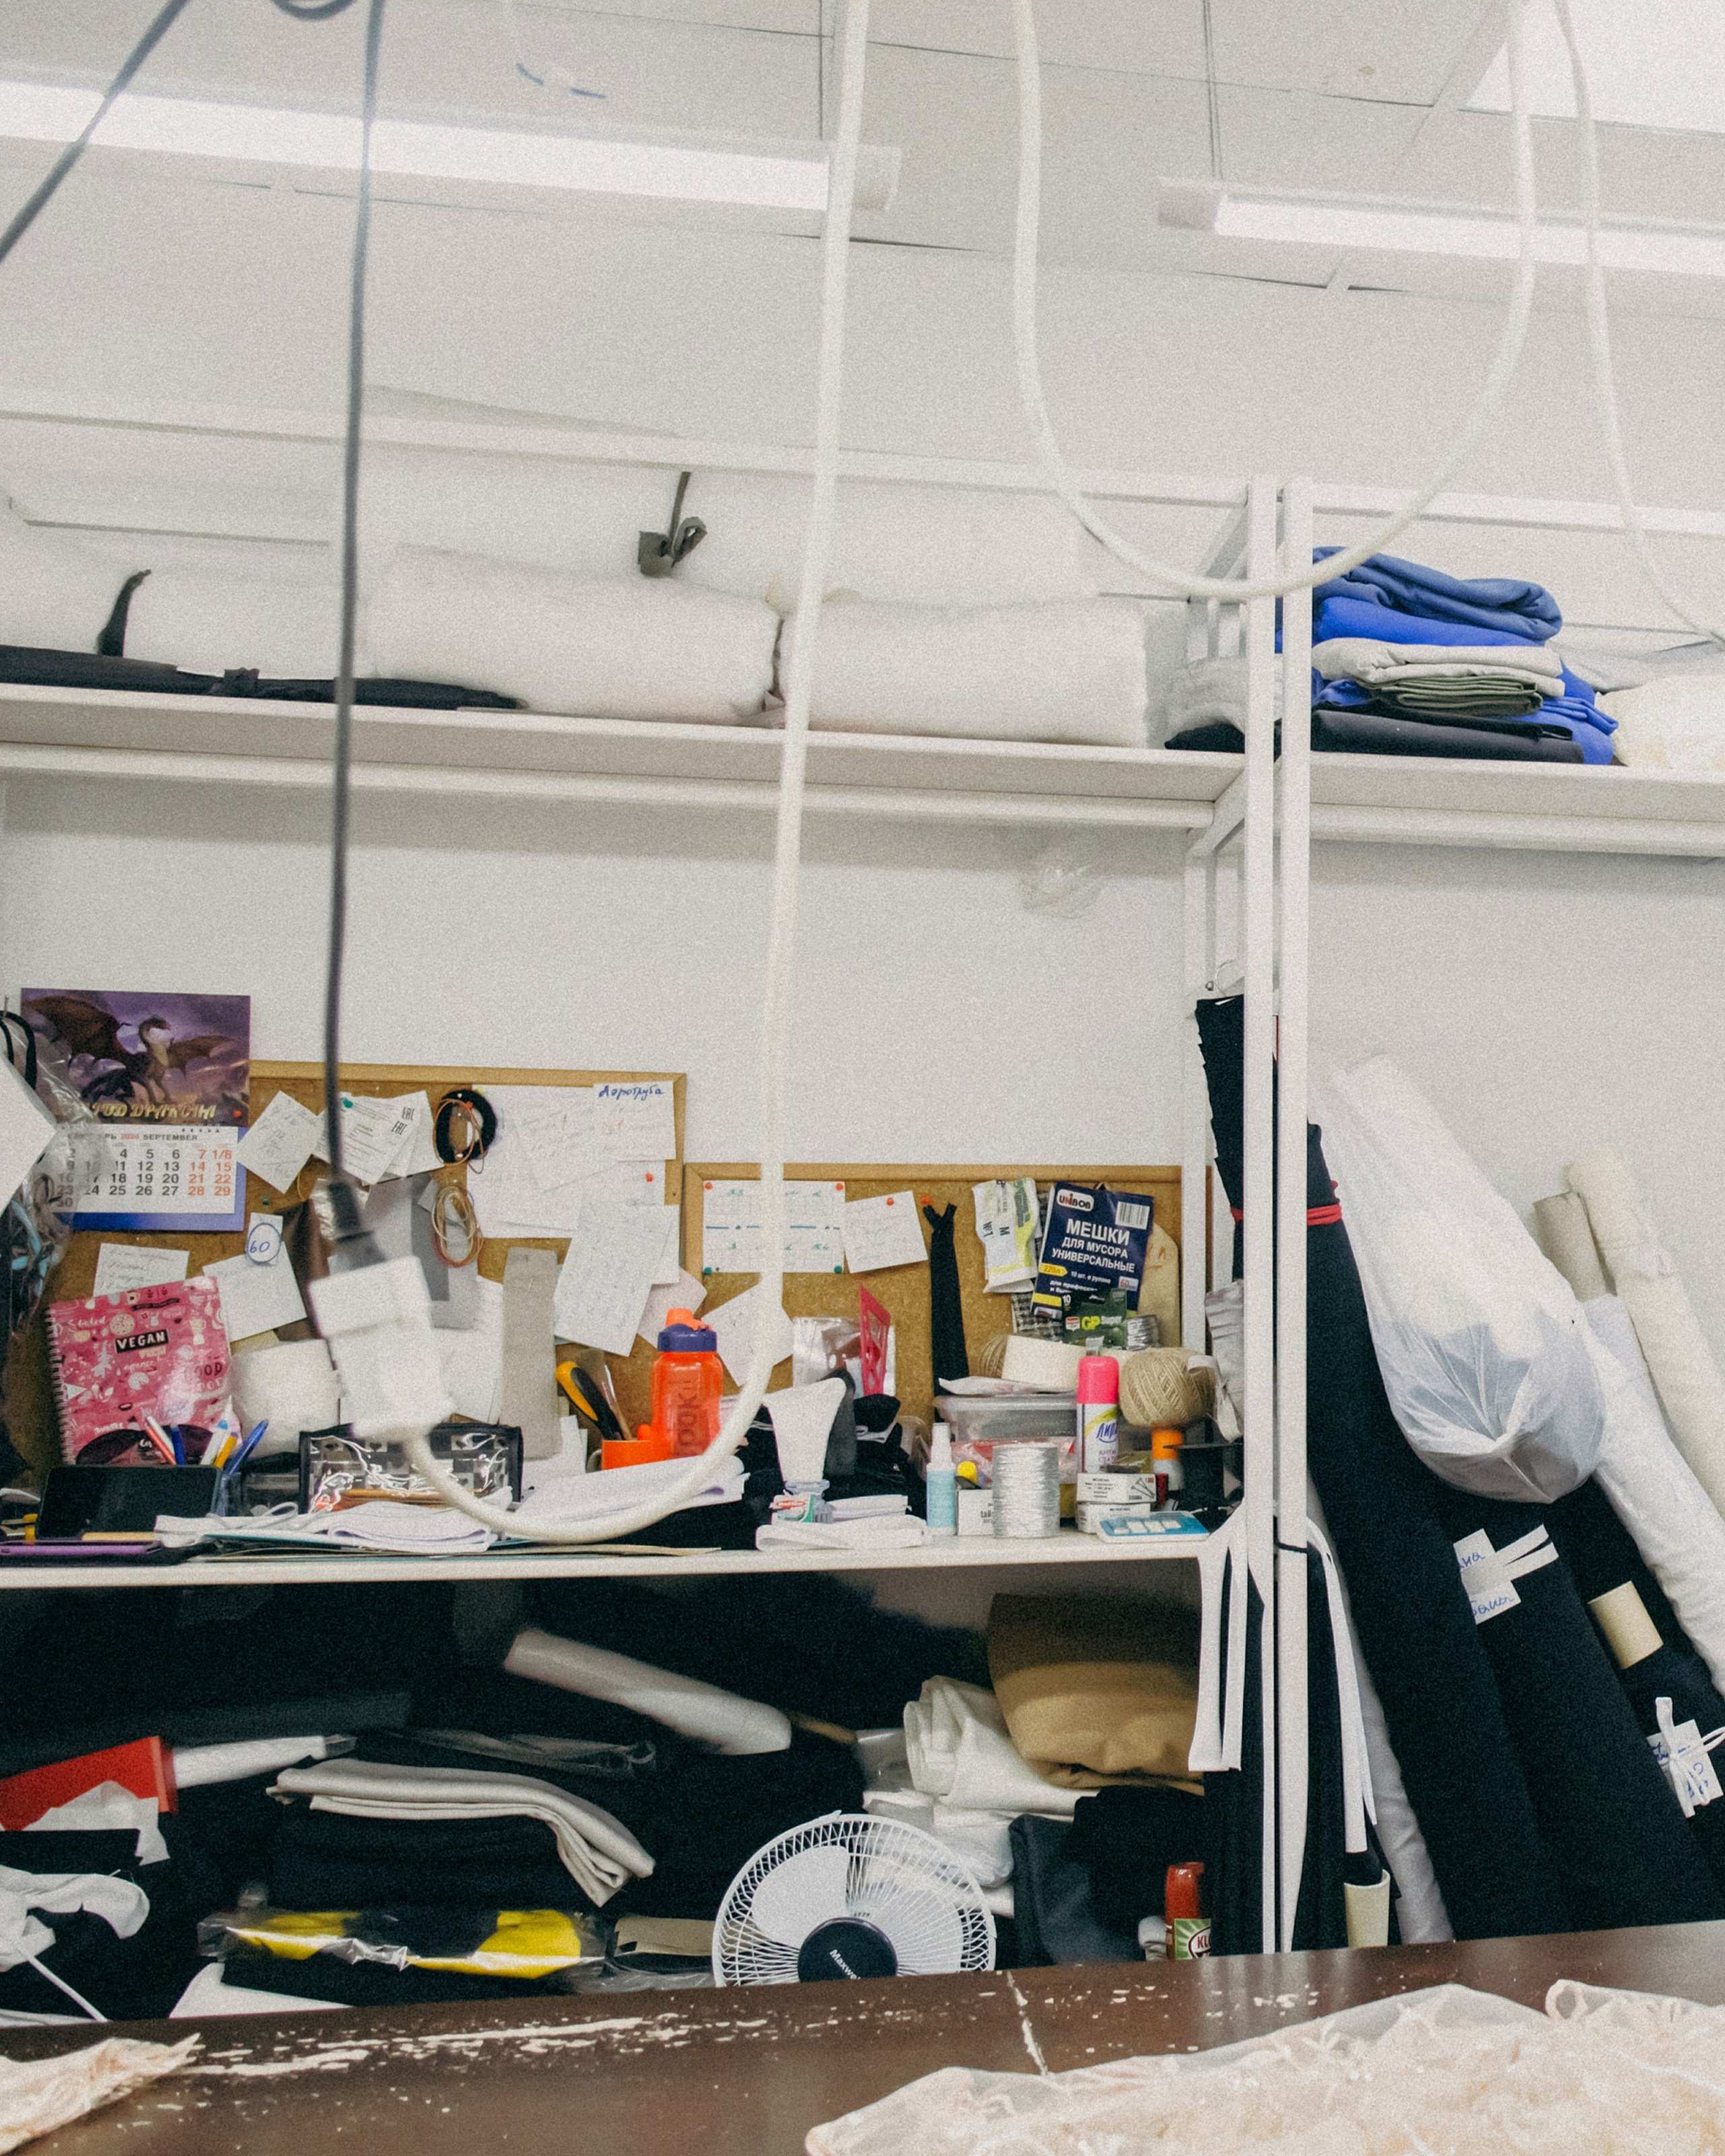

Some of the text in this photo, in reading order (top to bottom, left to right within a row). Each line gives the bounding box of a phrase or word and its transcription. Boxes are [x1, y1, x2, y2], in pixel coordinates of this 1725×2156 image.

[119, 1148, 127, 1158] 4
[146, 1148, 154, 1159] 5
[172, 1148, 180, 1159] 6
[199, 1149, 206, 1160] 7
[213, 1149, 232, 1160] 1/8
[137, 1161, 154, 1172] 12
[164, 1161, 179, 1172] 13
[190, 1161, 206, 1172] 14
[216, 1162, 232, 1172] 15
[111, 1173, 127, 1183] 18
[137, 1173, 154, 1183] 19
[162, 1173, 179, 1184] 20
[189, 1174, 204, 1184] 21
[214, 1174, 231, 1184] 22
[109, 1185, 126, 1195] 25
[135, 1186, 152, 1195] 26
[162, 1186, 179, 1196] 27
[188, 1186, 205, 1196] 28
[214, 1186, 231, 1196] 29
[1066, 1218, 1130, 1246] МЕШКИ
[249, 1240, 270, 1253] 60
[1061, 1237, 1128, 1259] ДЛЯ МУСОРА
[1052, 1248, 1135, 1273] УНИВЕРСАЛЬНЫЕ
[1081, 1316, 1100, 1330] GP
[117, 1331, 166, 1350] VEGAN
[829, 1949, 861, 1979] Maxwe
